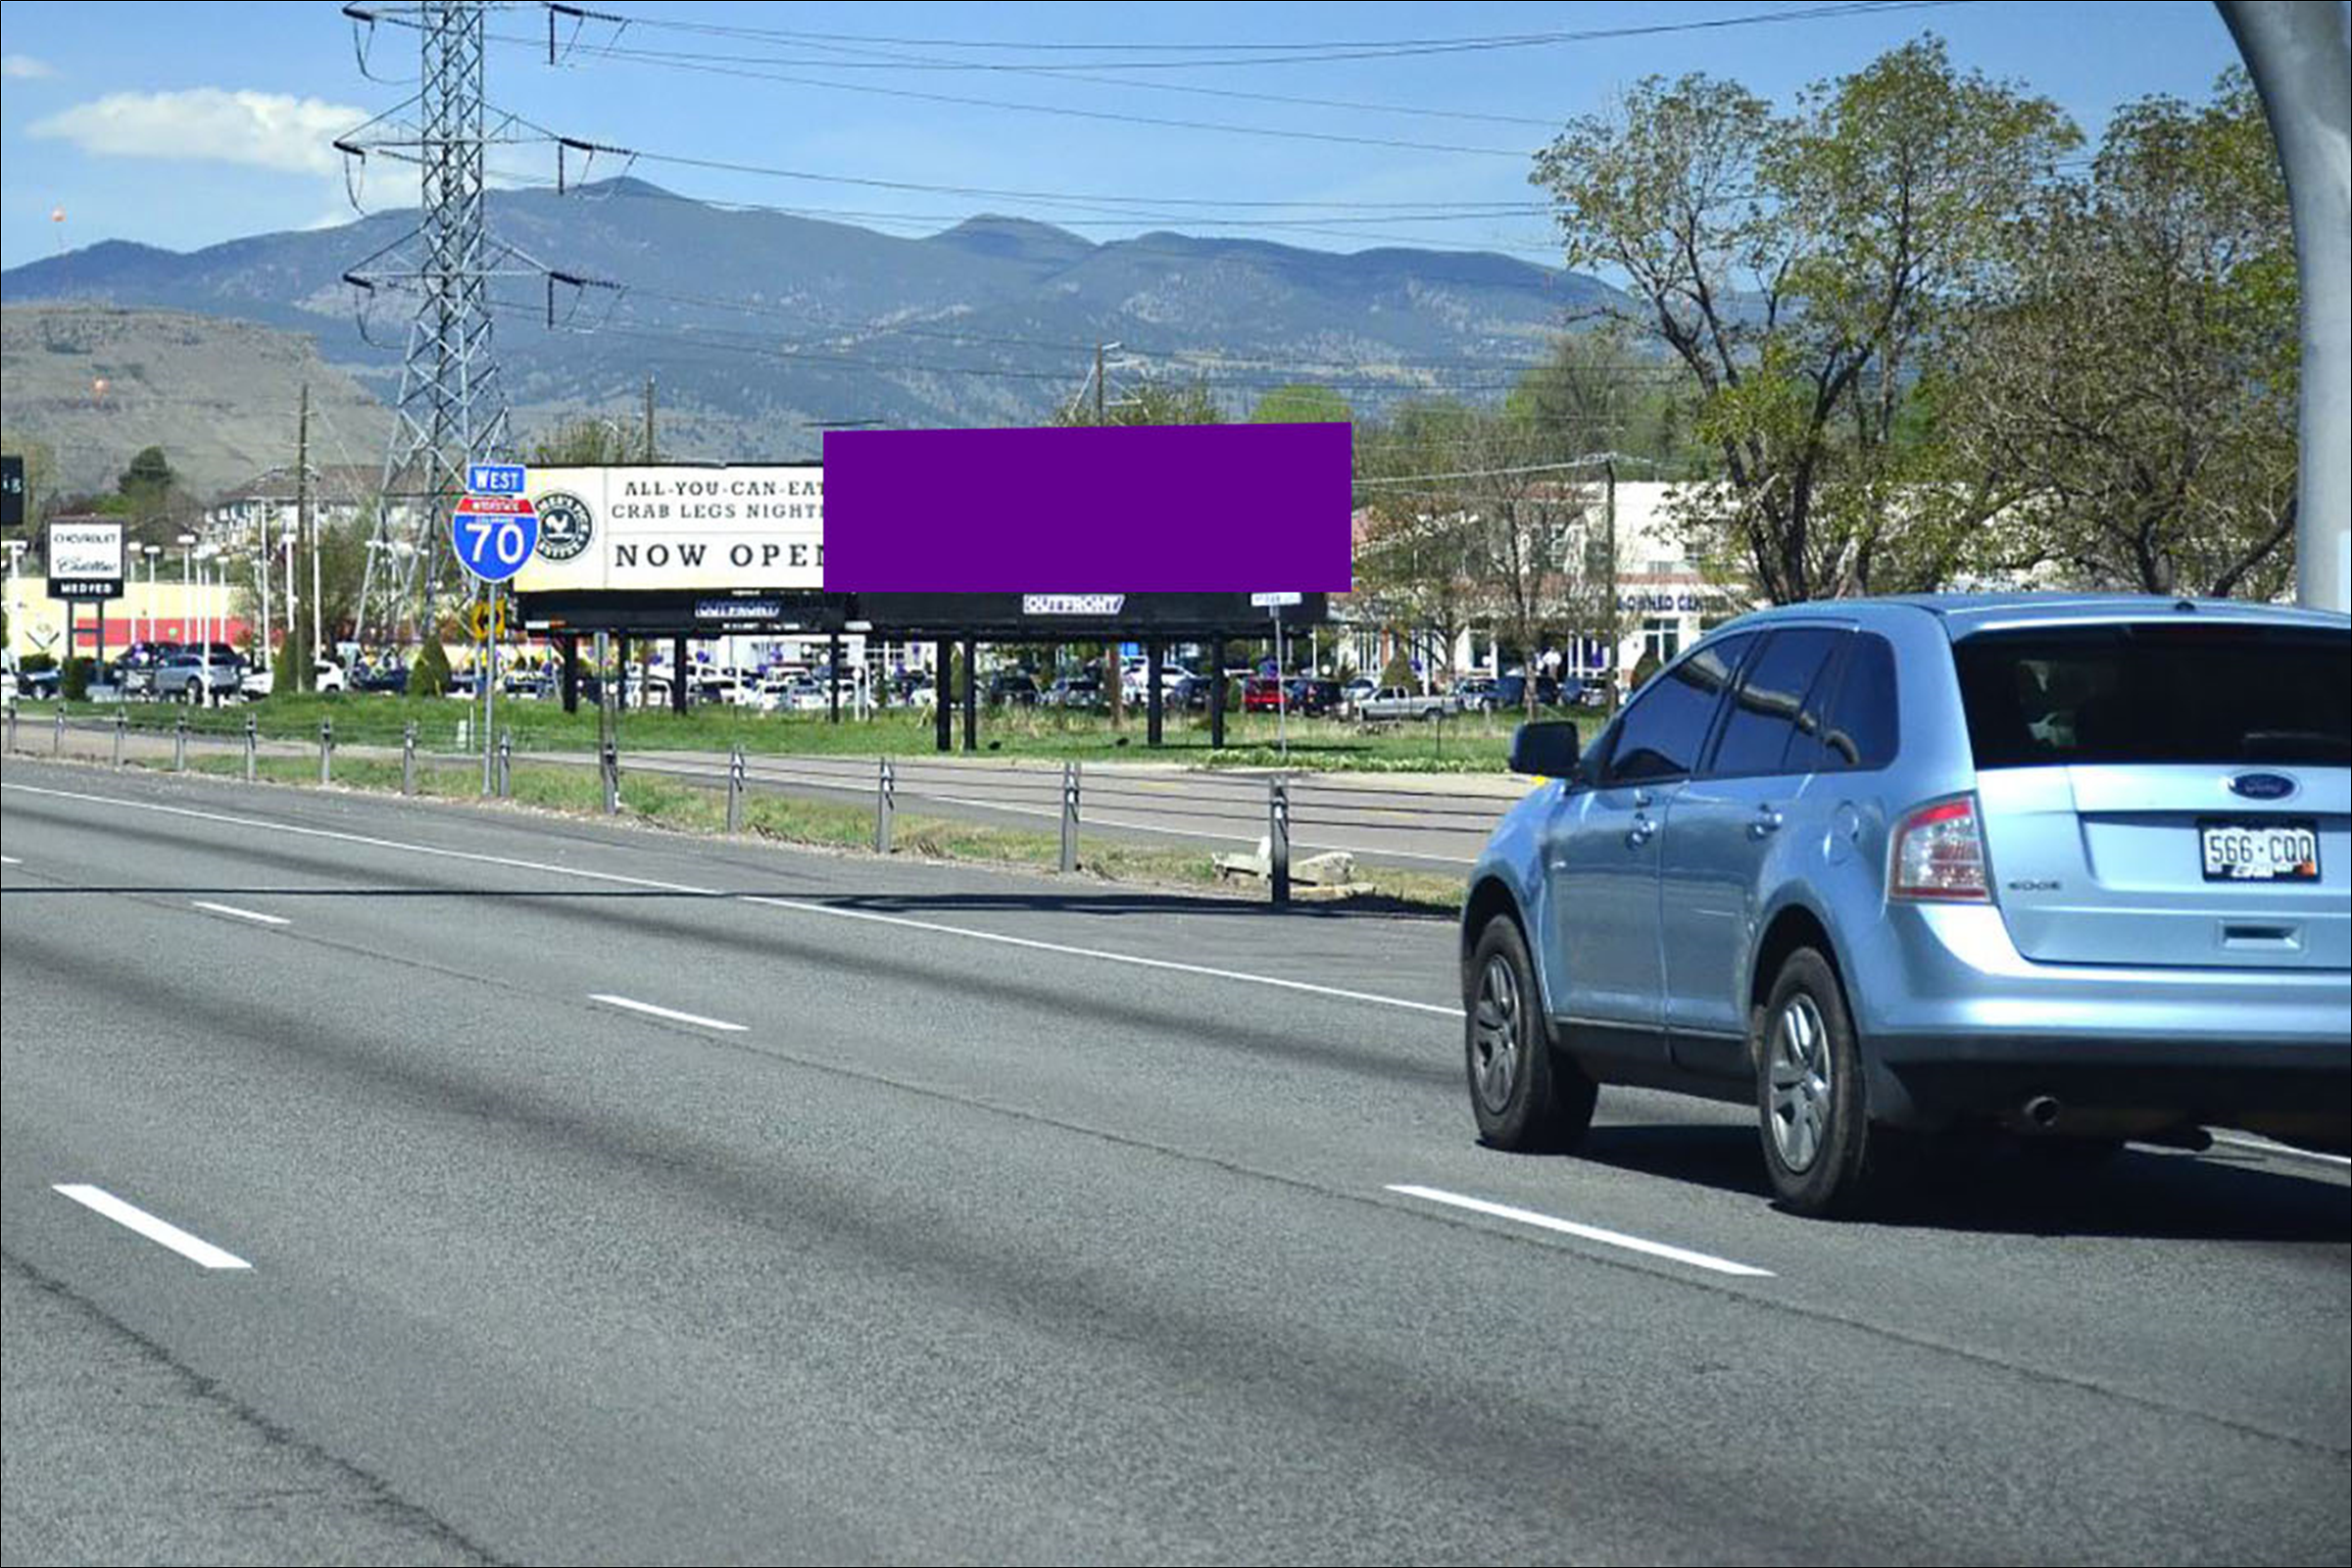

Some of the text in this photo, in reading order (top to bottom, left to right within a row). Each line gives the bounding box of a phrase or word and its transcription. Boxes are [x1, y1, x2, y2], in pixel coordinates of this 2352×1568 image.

[474, 469, 519, 489] WEST
[612, 504, 670, 518] CRAB
[680, 504, 736, 518] LEGS
[466, 522, 524, 564] 70
[615, 544, 707, 567] NOW
[1025, 596, 1120, 612] OUTFRONT
